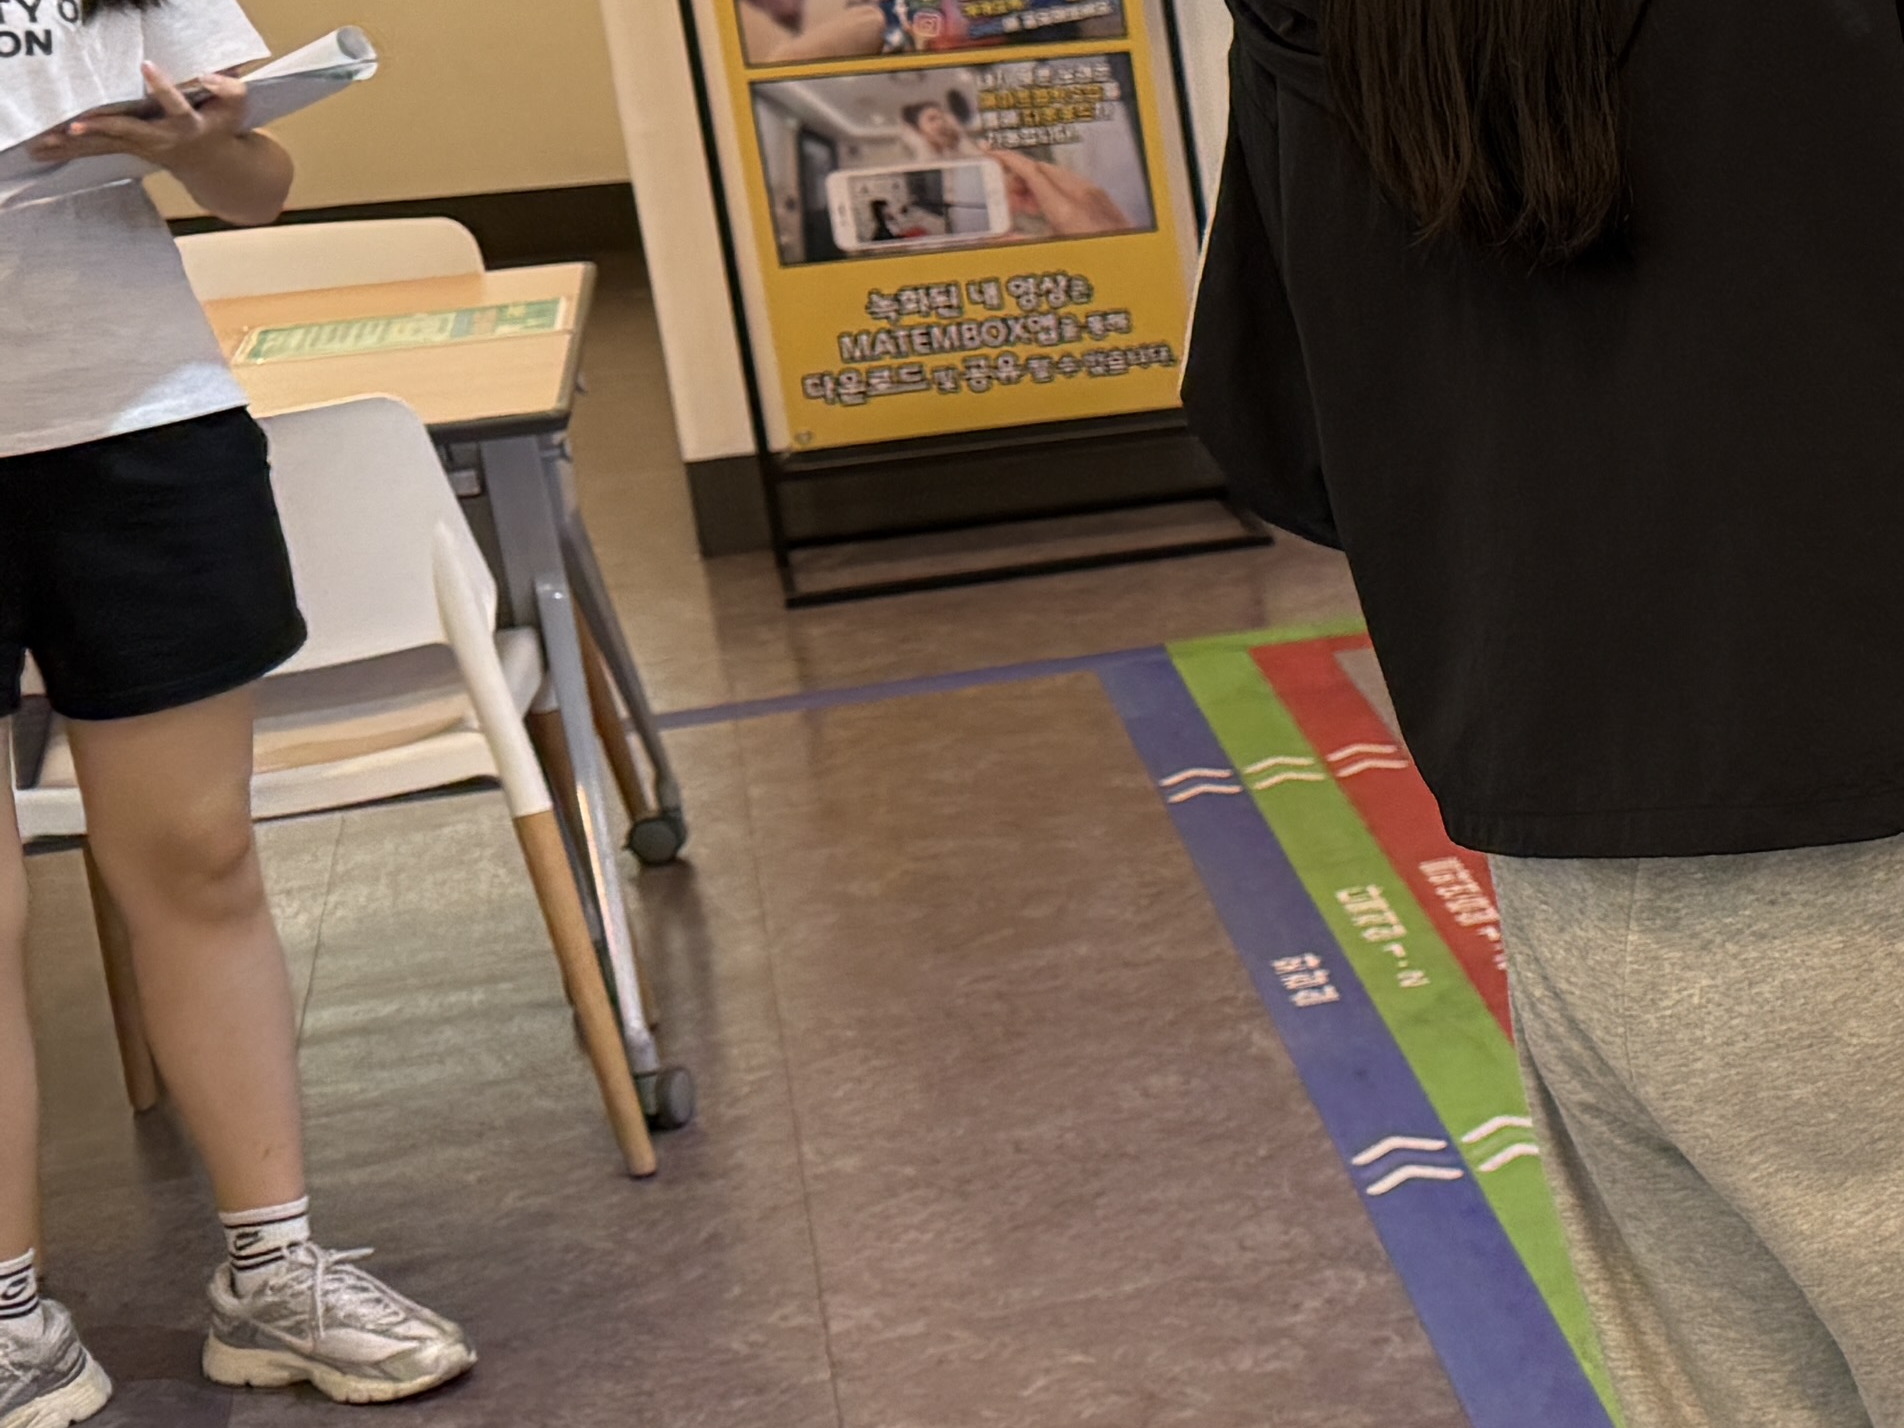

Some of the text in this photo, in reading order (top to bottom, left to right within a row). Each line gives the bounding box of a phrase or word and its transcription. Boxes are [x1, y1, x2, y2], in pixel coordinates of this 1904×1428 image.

[866, 270, 1094, 324] 녹화된 내 영상은
[802, 362, 931, 406] 다운로드
[962, 351, 1024, 394] 공유
